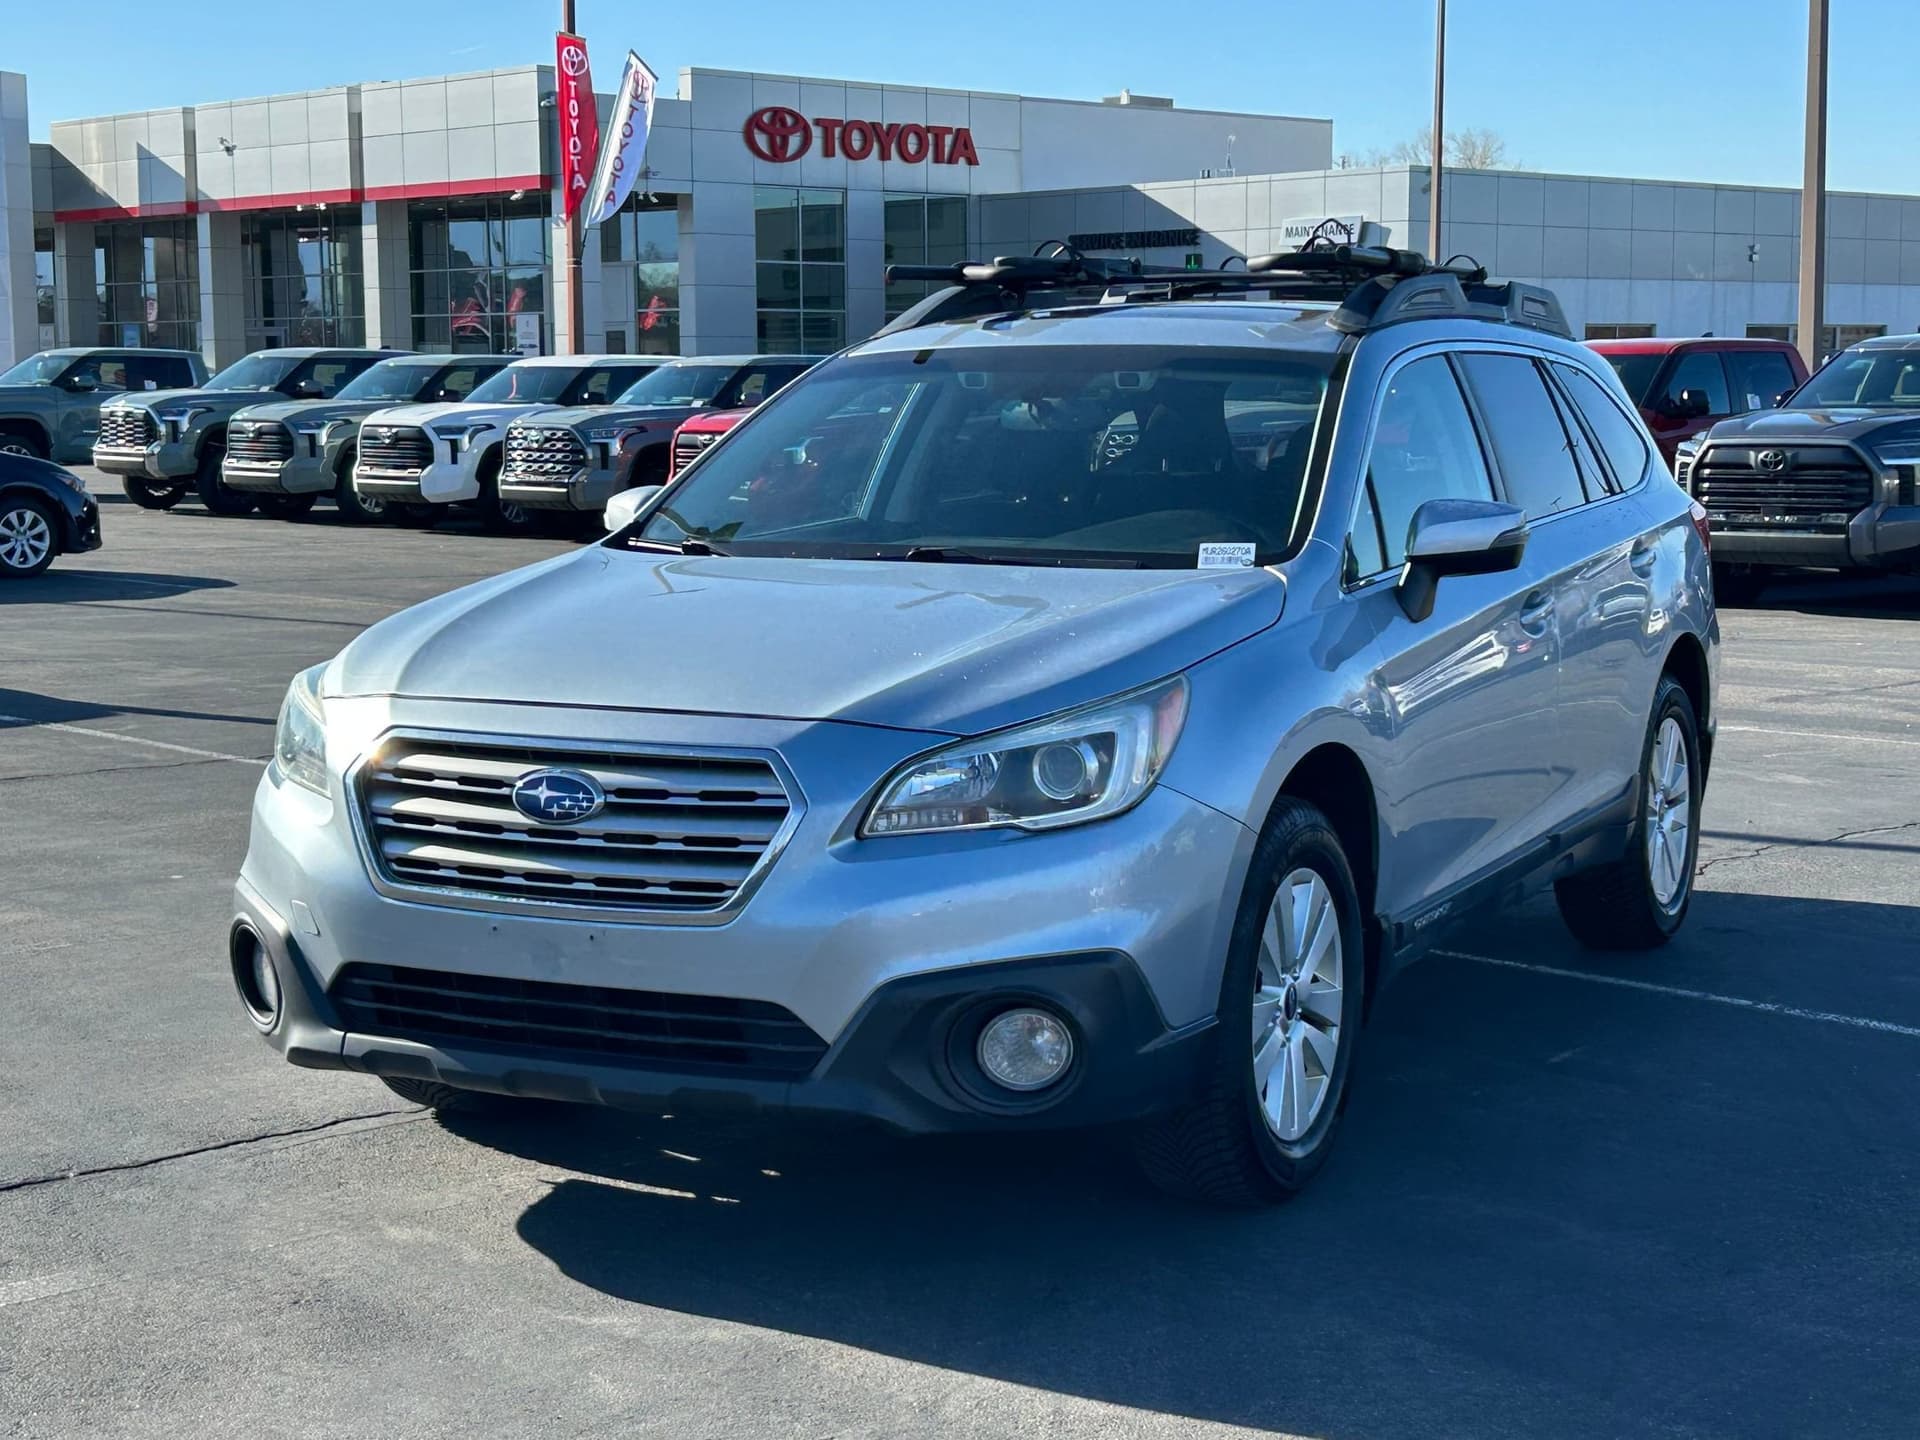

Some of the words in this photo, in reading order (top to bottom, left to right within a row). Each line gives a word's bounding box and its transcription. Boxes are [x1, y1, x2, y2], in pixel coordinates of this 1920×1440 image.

[568, 81, 587, 190] TOYOTA
[604, 104, 639, 206] TOYOTA
[813, 118, 980, 166] TOYOTA
